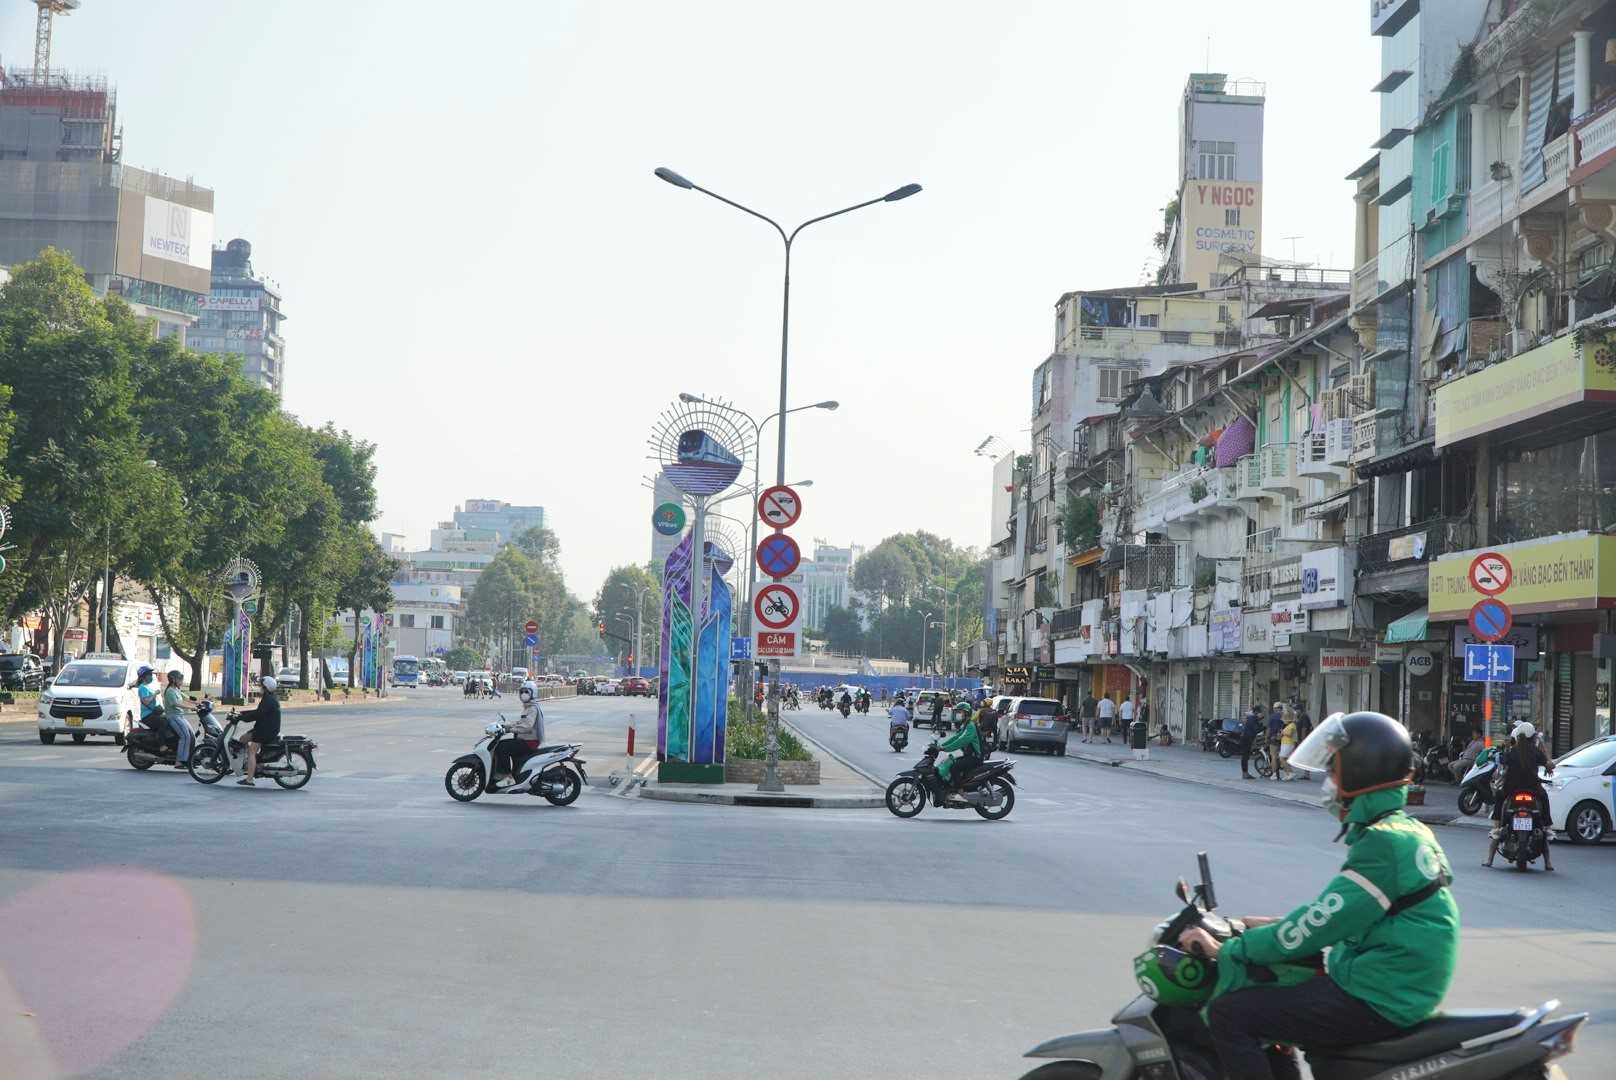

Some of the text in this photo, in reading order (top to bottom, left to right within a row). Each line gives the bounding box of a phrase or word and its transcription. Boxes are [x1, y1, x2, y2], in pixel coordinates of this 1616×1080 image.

[1196, 227, 1255, 240] COSMETIC
[1195, 240, 1256, 253] SURGERY
[209, 296, 252, 305] CAPELLA
[1409, 656, 1431, 666] ACB
